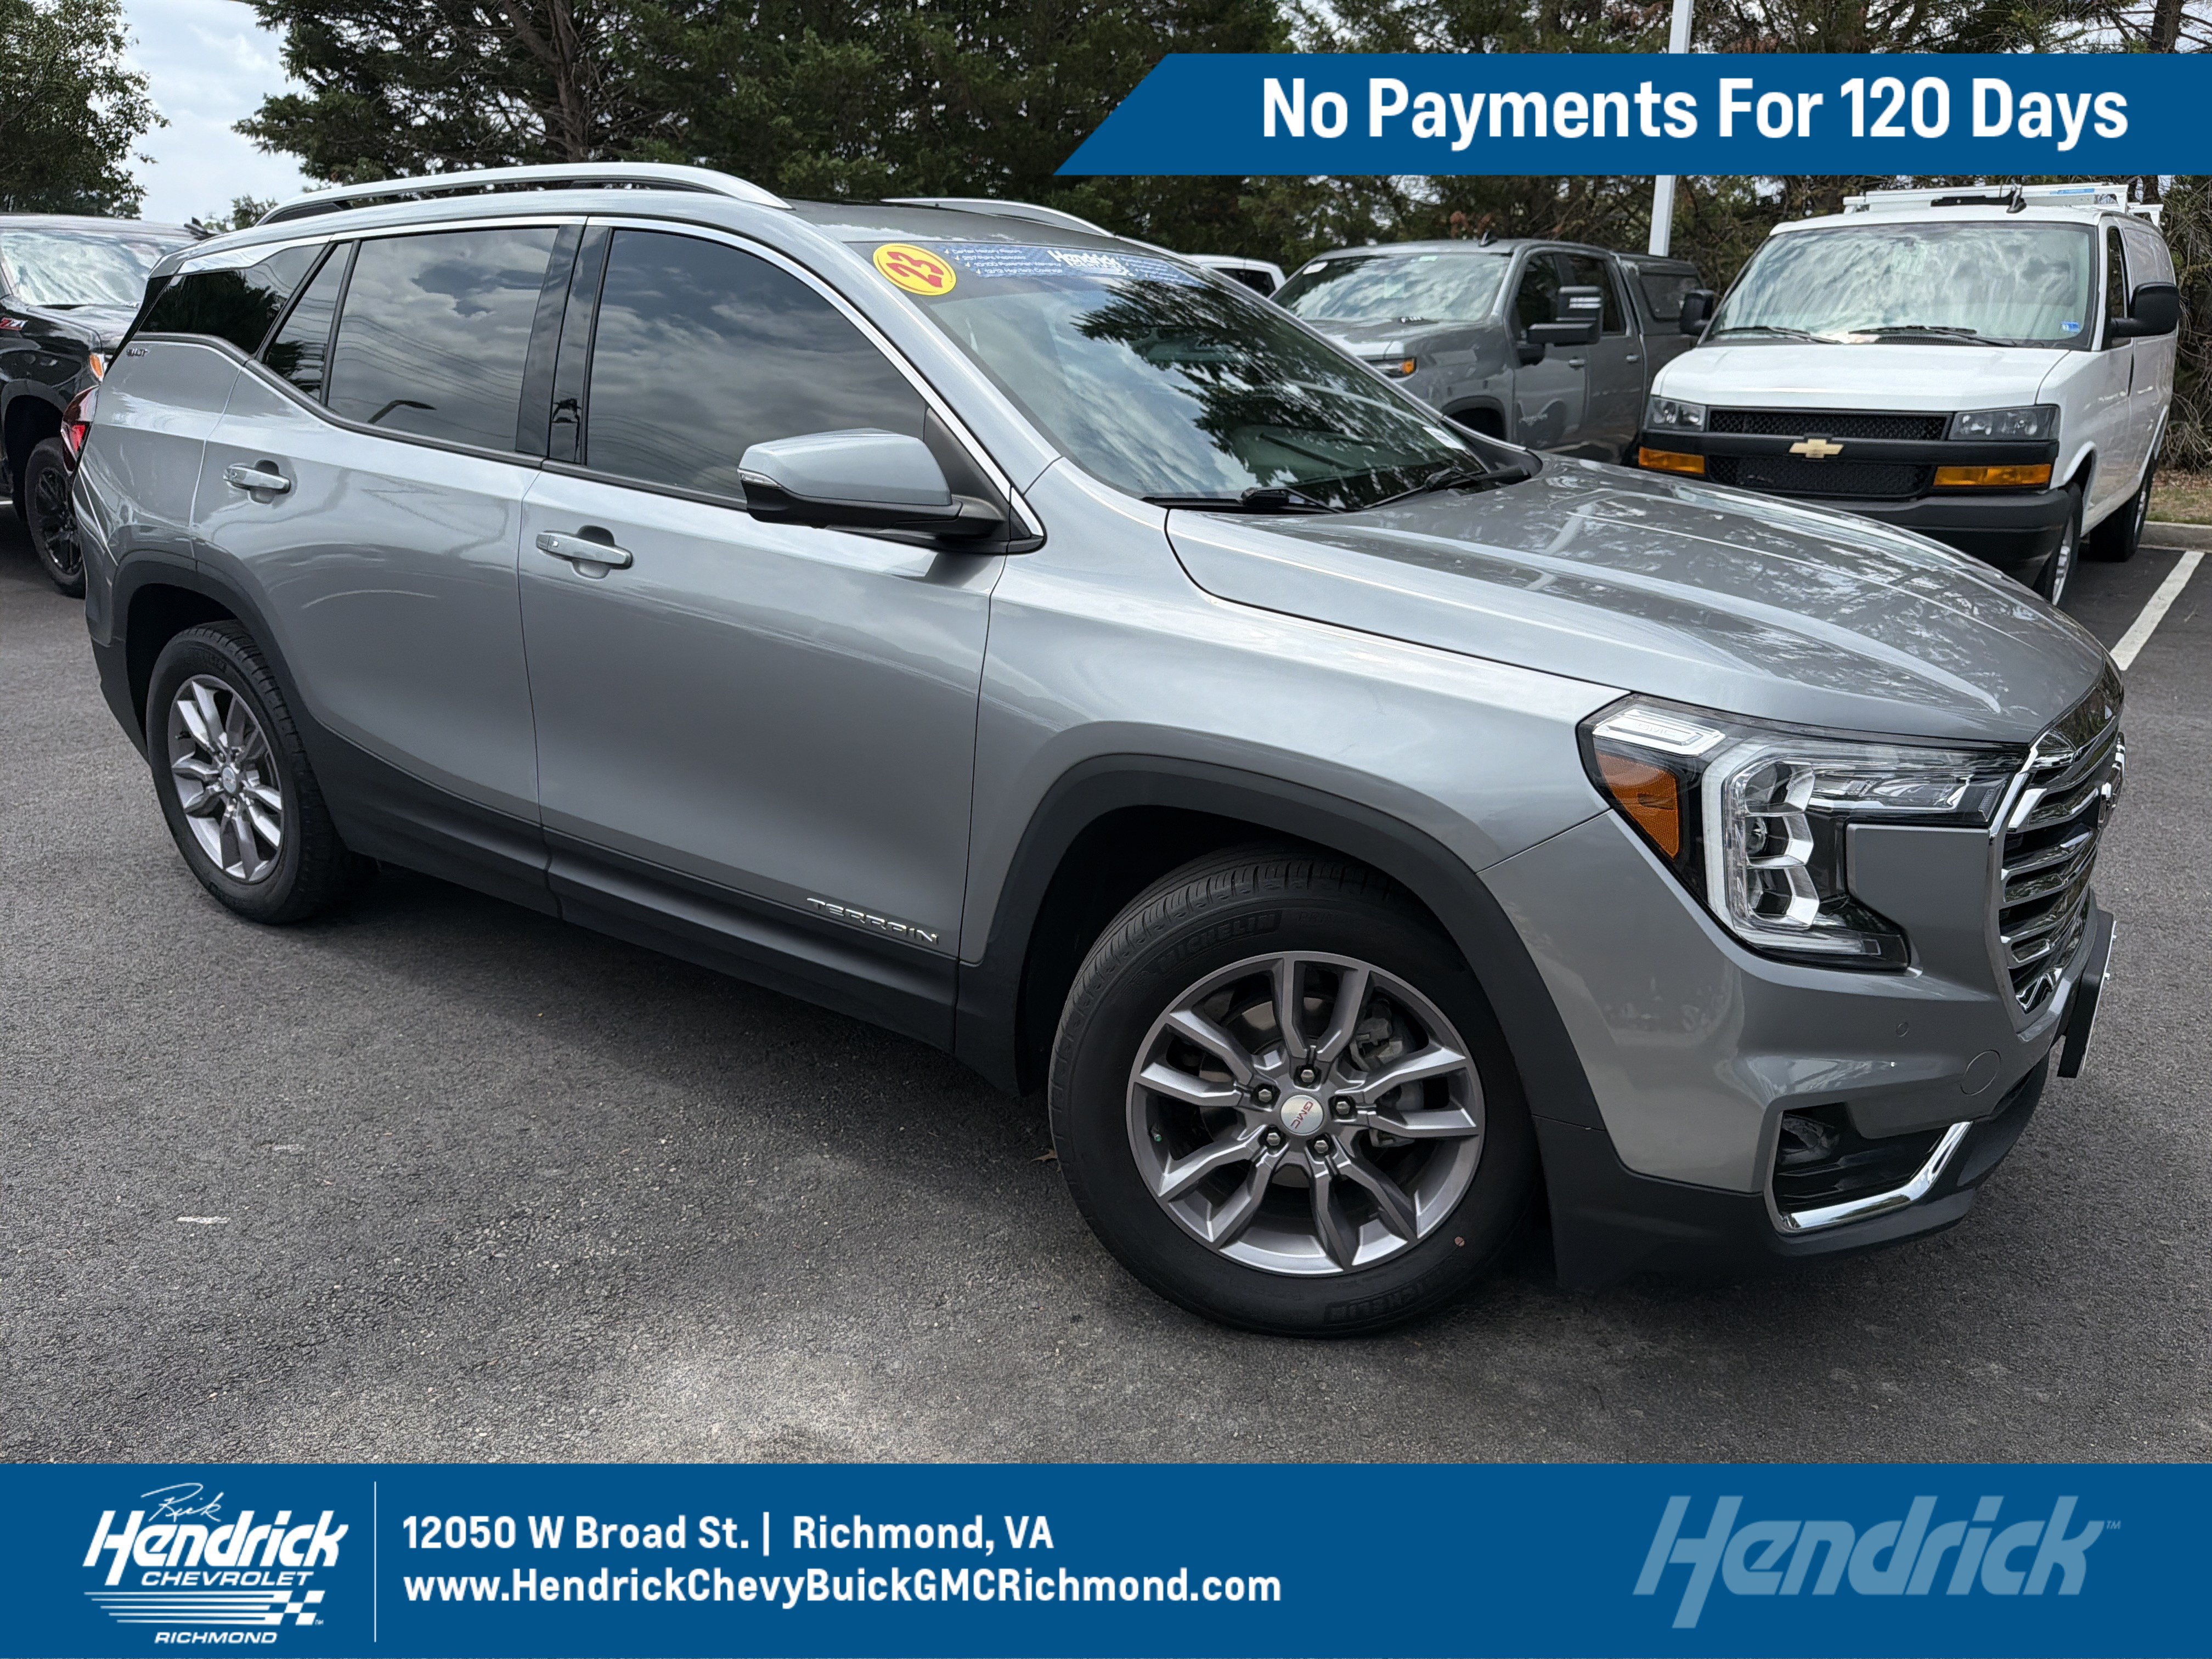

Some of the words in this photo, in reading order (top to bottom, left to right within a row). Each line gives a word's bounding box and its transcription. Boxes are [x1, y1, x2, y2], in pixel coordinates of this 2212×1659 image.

[885, 251, 944, 288] 23
[806, 898, 939, 945] TERRAIN
[1290, 1101, 1313, 1129] GMC
